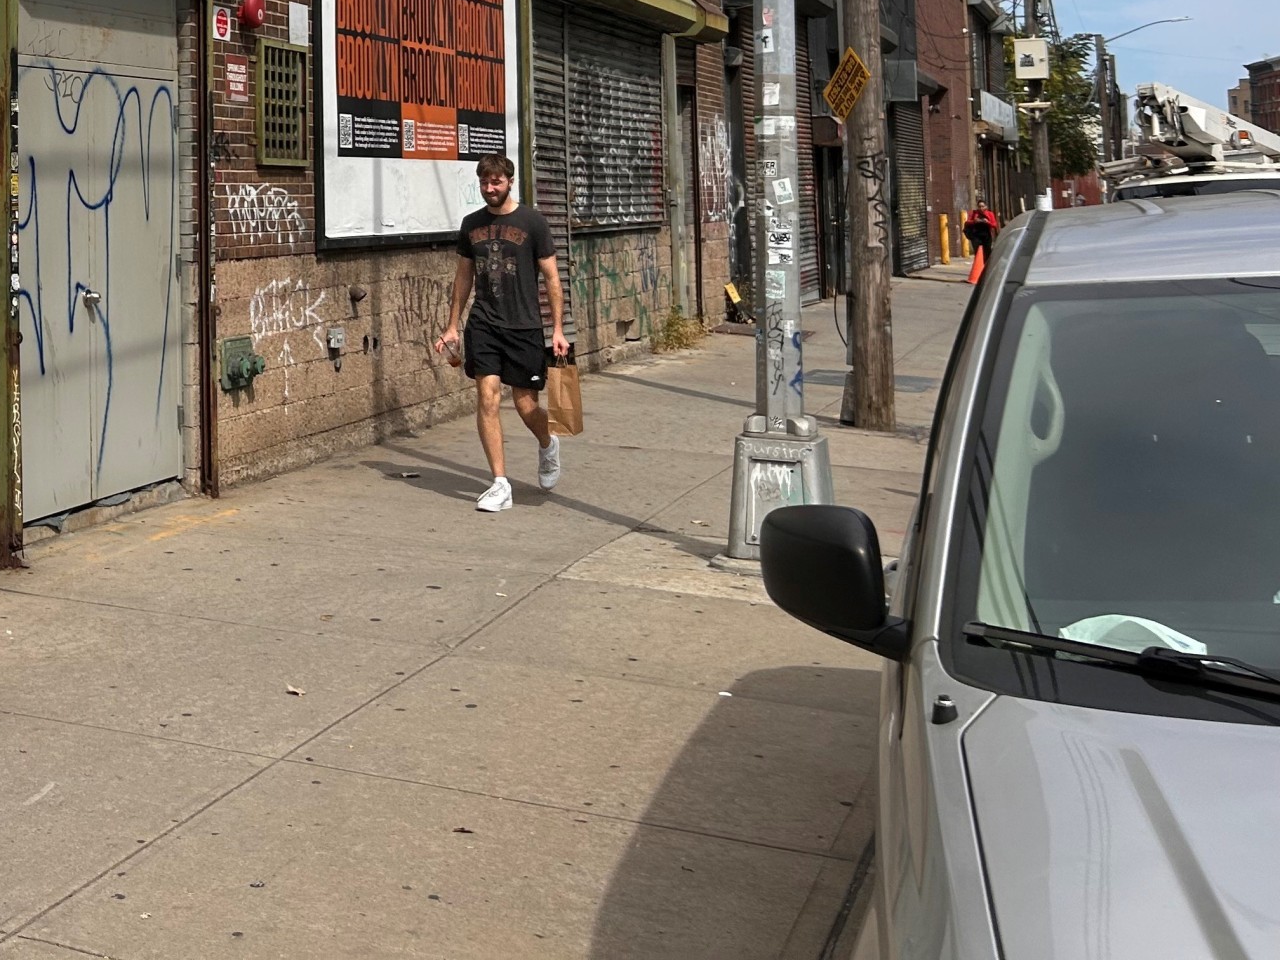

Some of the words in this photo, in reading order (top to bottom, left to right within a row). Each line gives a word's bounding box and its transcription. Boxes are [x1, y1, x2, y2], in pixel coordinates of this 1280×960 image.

[337, 33, 400, 102] BROOKLYN
[402, 46, 456, 108] BROOKLYN
[457, 55, 505, 115] BROOKLYN
